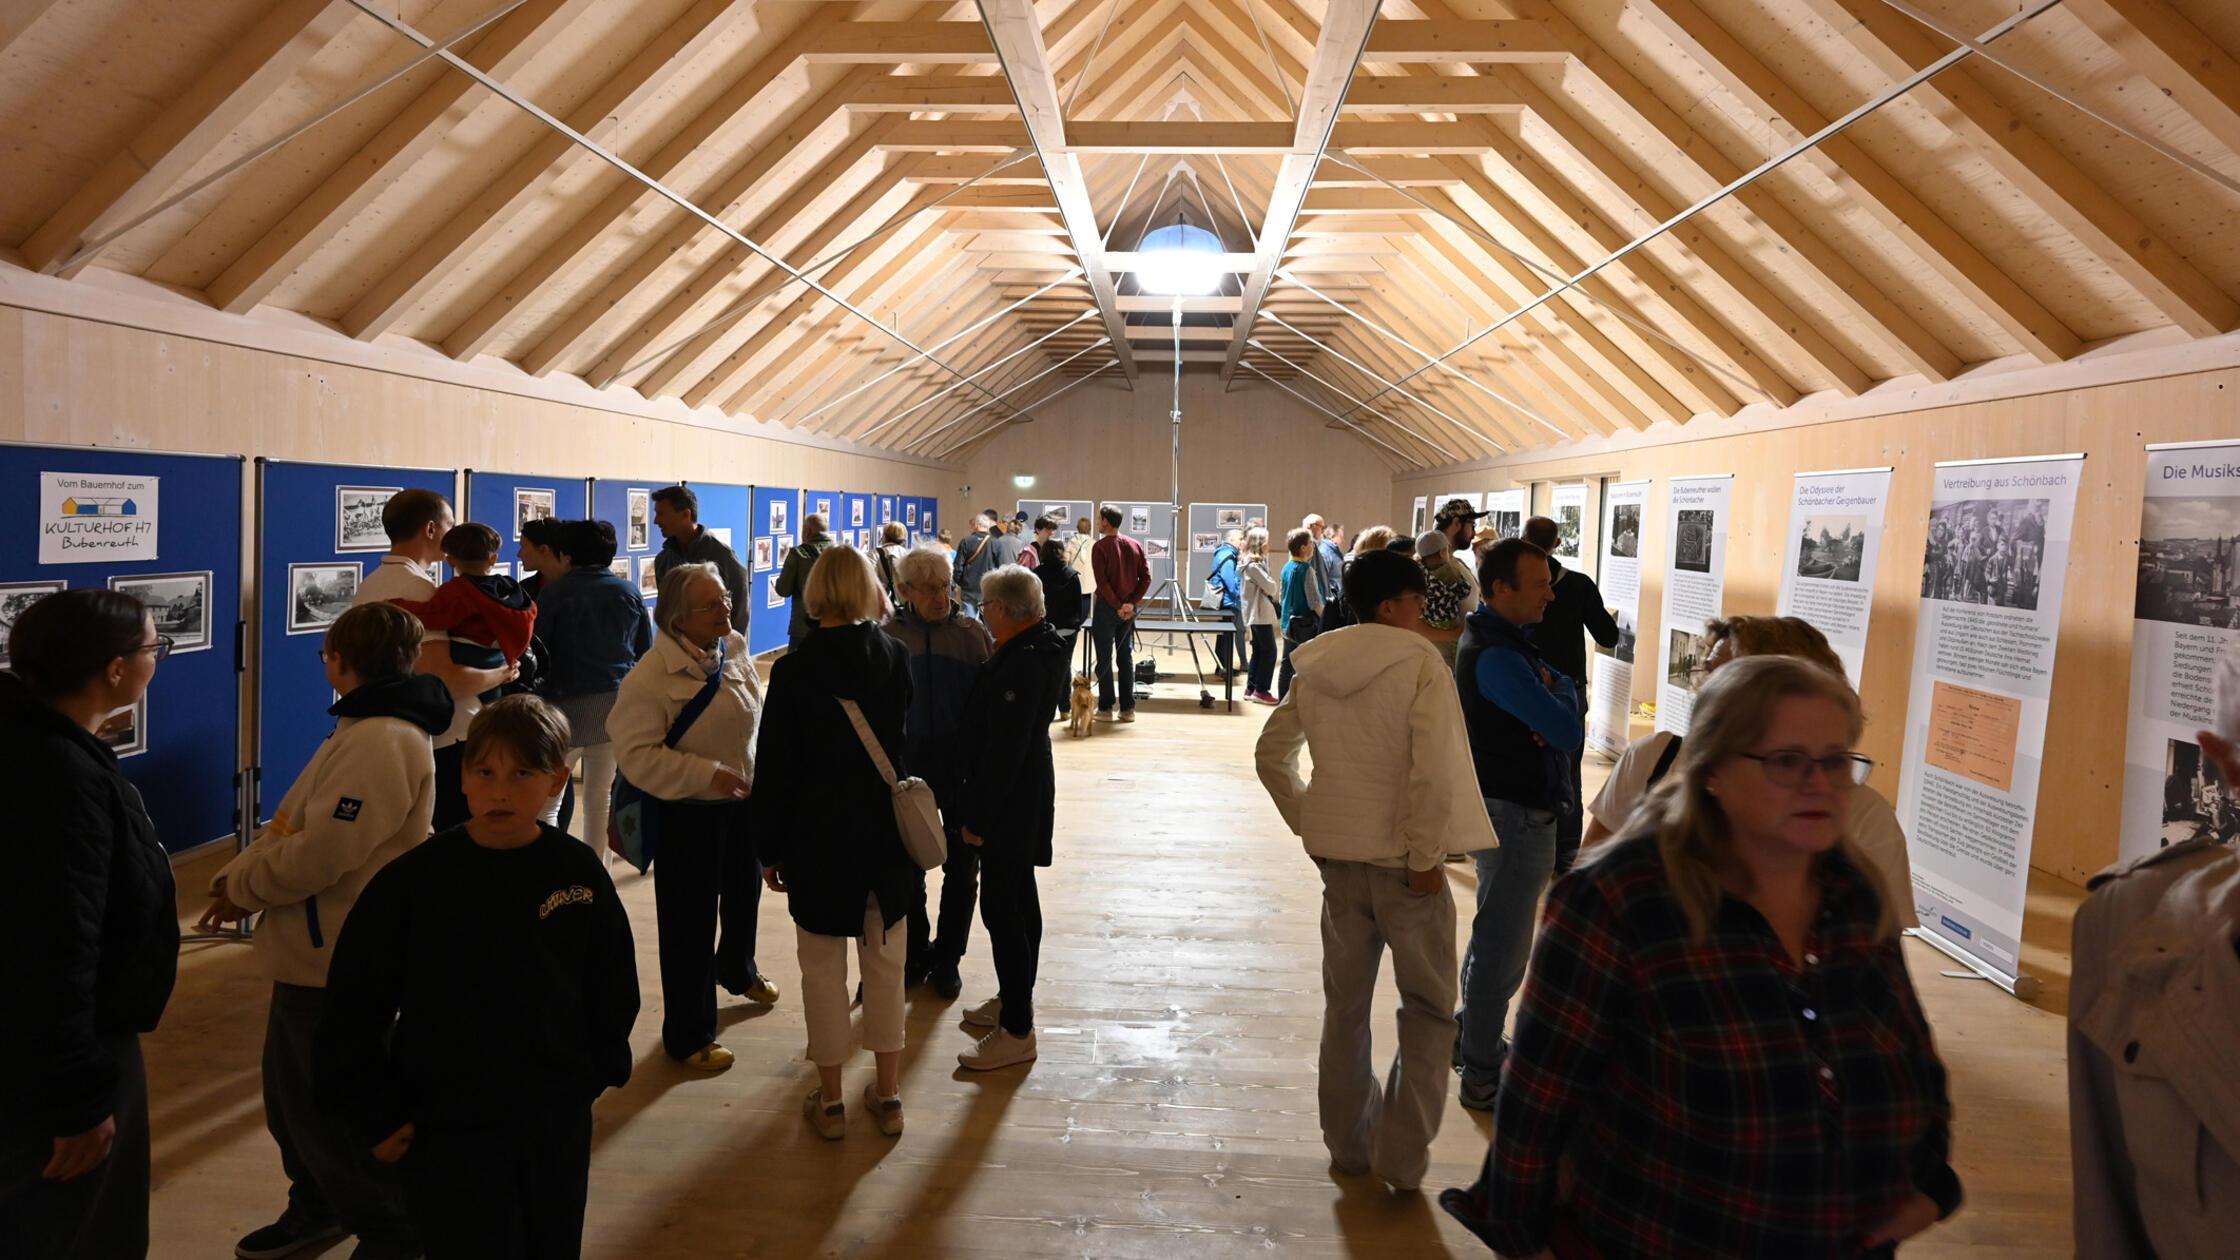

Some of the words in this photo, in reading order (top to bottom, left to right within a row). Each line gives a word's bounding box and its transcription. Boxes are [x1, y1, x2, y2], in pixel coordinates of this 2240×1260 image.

[2163, 465, 2187, 479] Die
[57, 479, 78, 488] Vom
[80, 480, 125, 489] Bauernhof
[1943, 477, 1992, 490] Vertreibung
[1994, 477, 2009, 487] aus
[2012, 474, 2067, 487] Schönbach
[1799, 486, 1809, 494] Die
[45, 522, 133, 534] KULTURHOF
[135, 521, 152, 534] H7
[62, 536, 139, 549] Bubenreuth
[2189, 633, 2206, 642] dem
[2174, 641, 2198, 652] Bayern
[2200, 644, 2214, 653] und
[2170, 710, 2182, 719] der
